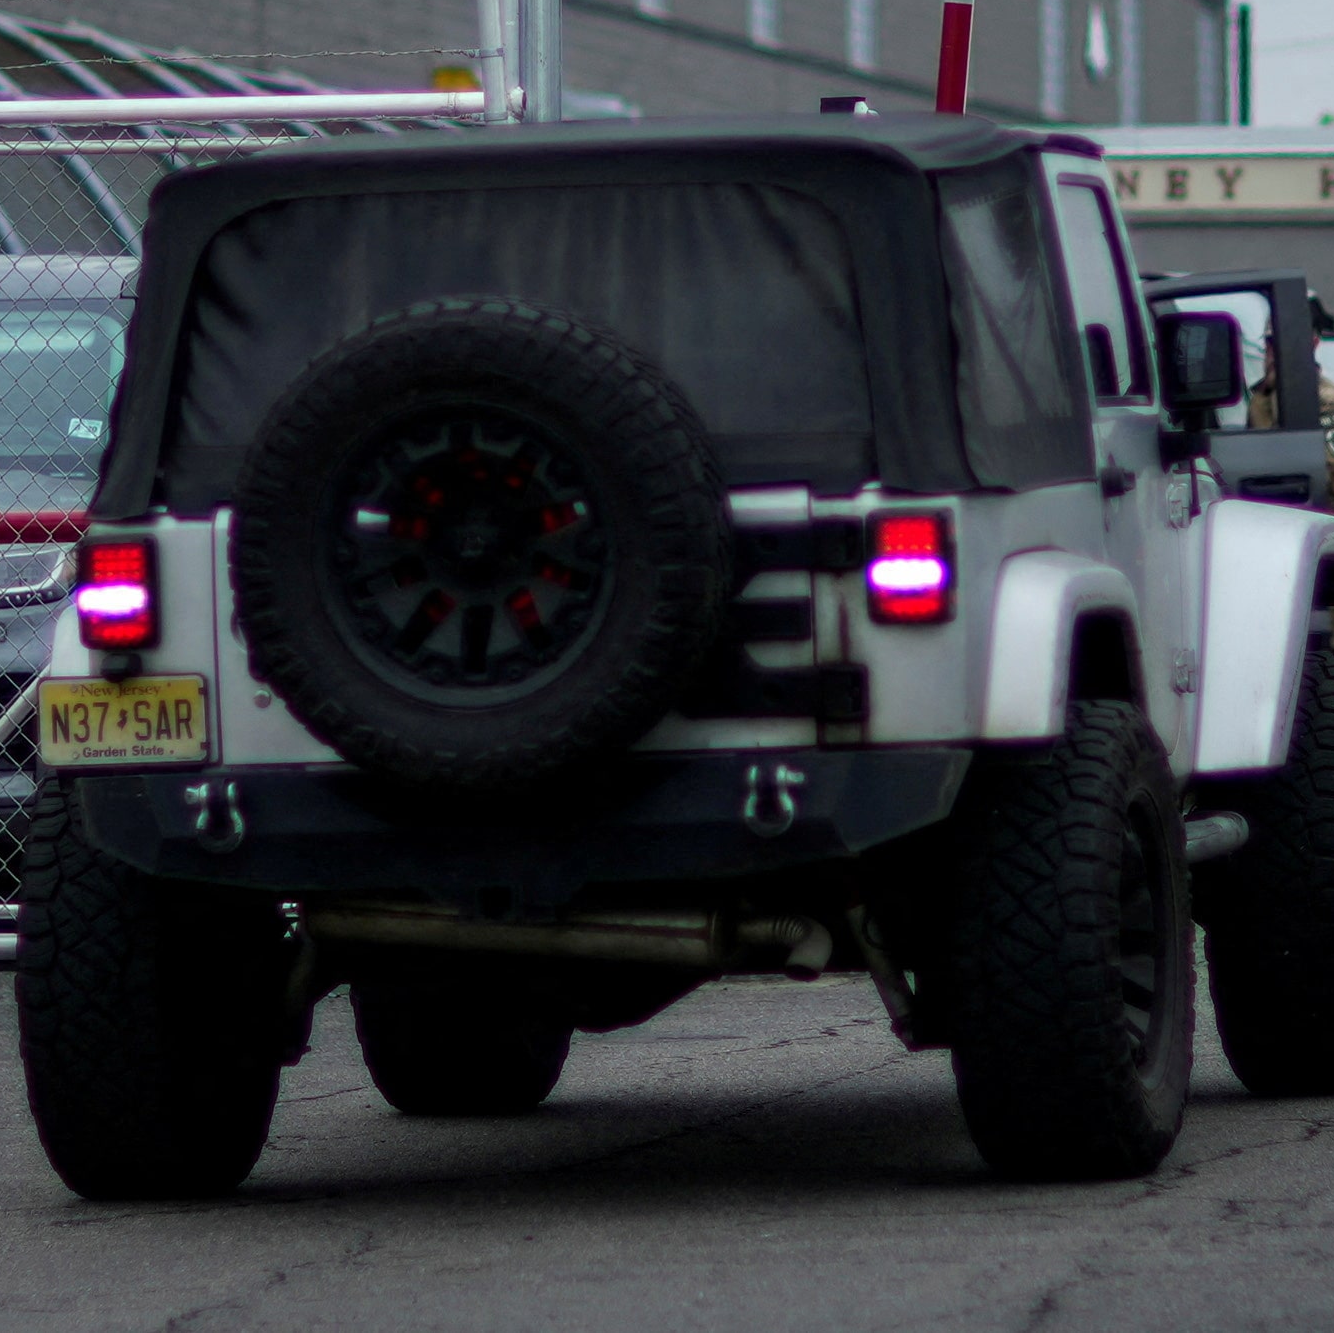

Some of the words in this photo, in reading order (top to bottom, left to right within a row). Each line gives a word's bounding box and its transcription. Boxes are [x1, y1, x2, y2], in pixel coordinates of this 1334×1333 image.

[79, 684, 113, 697] New
[116, 683, 163, 698] Jersey
[51, 701, 110, 744] N37
[133, 698, 194, 741] SAR
[82, 746, 127, 759] Garden
[131, 745, 165, 757] State
